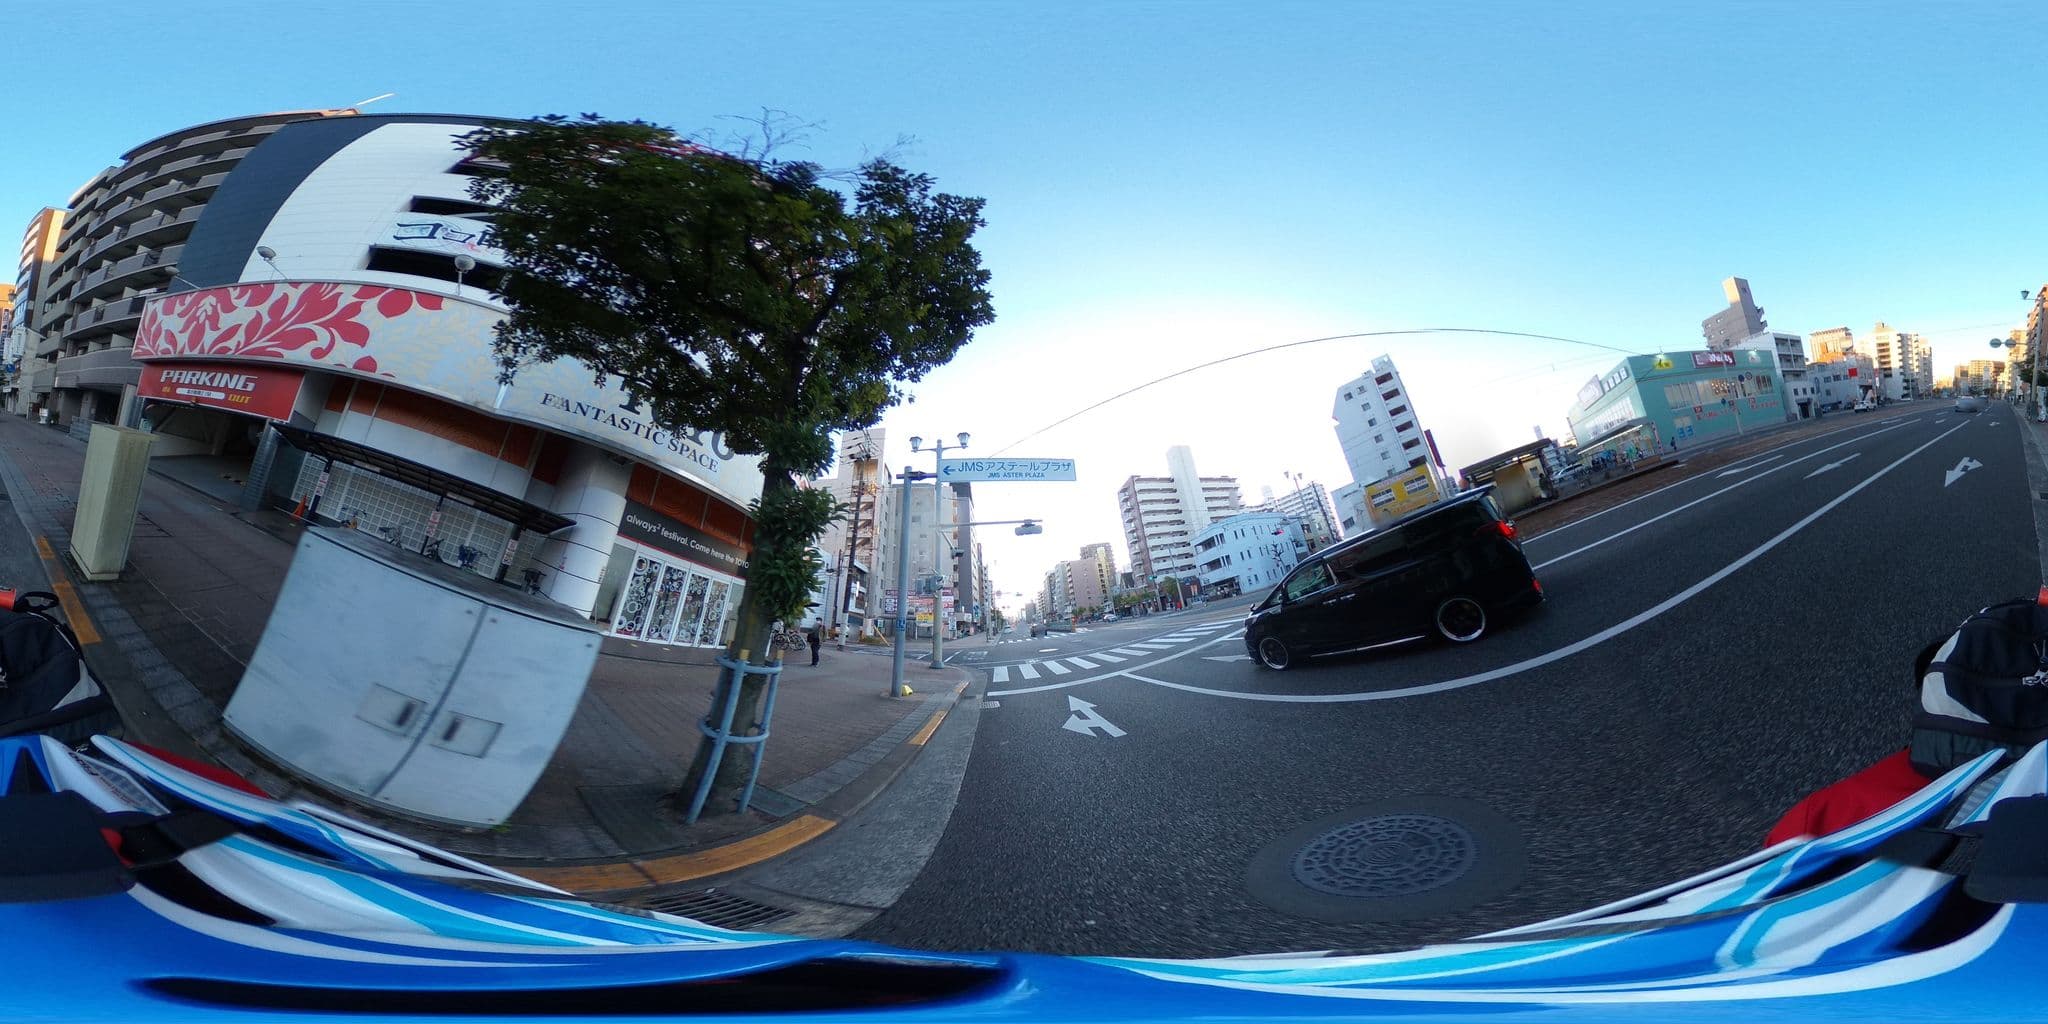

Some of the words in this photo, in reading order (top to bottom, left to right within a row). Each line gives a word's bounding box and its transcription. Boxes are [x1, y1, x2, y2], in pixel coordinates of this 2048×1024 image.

[160, 370, 258, 392] PARKING
[228, 393, 252, 403] OUT
[540, 393, 665, 445] FANTASTIC
[667, 439, 719, 473] SPACE
[958, 461, 1072, 472] JMSアステールプラザ
[690, 540, 710, 554] Come
[711, 548, 725, 560] here
